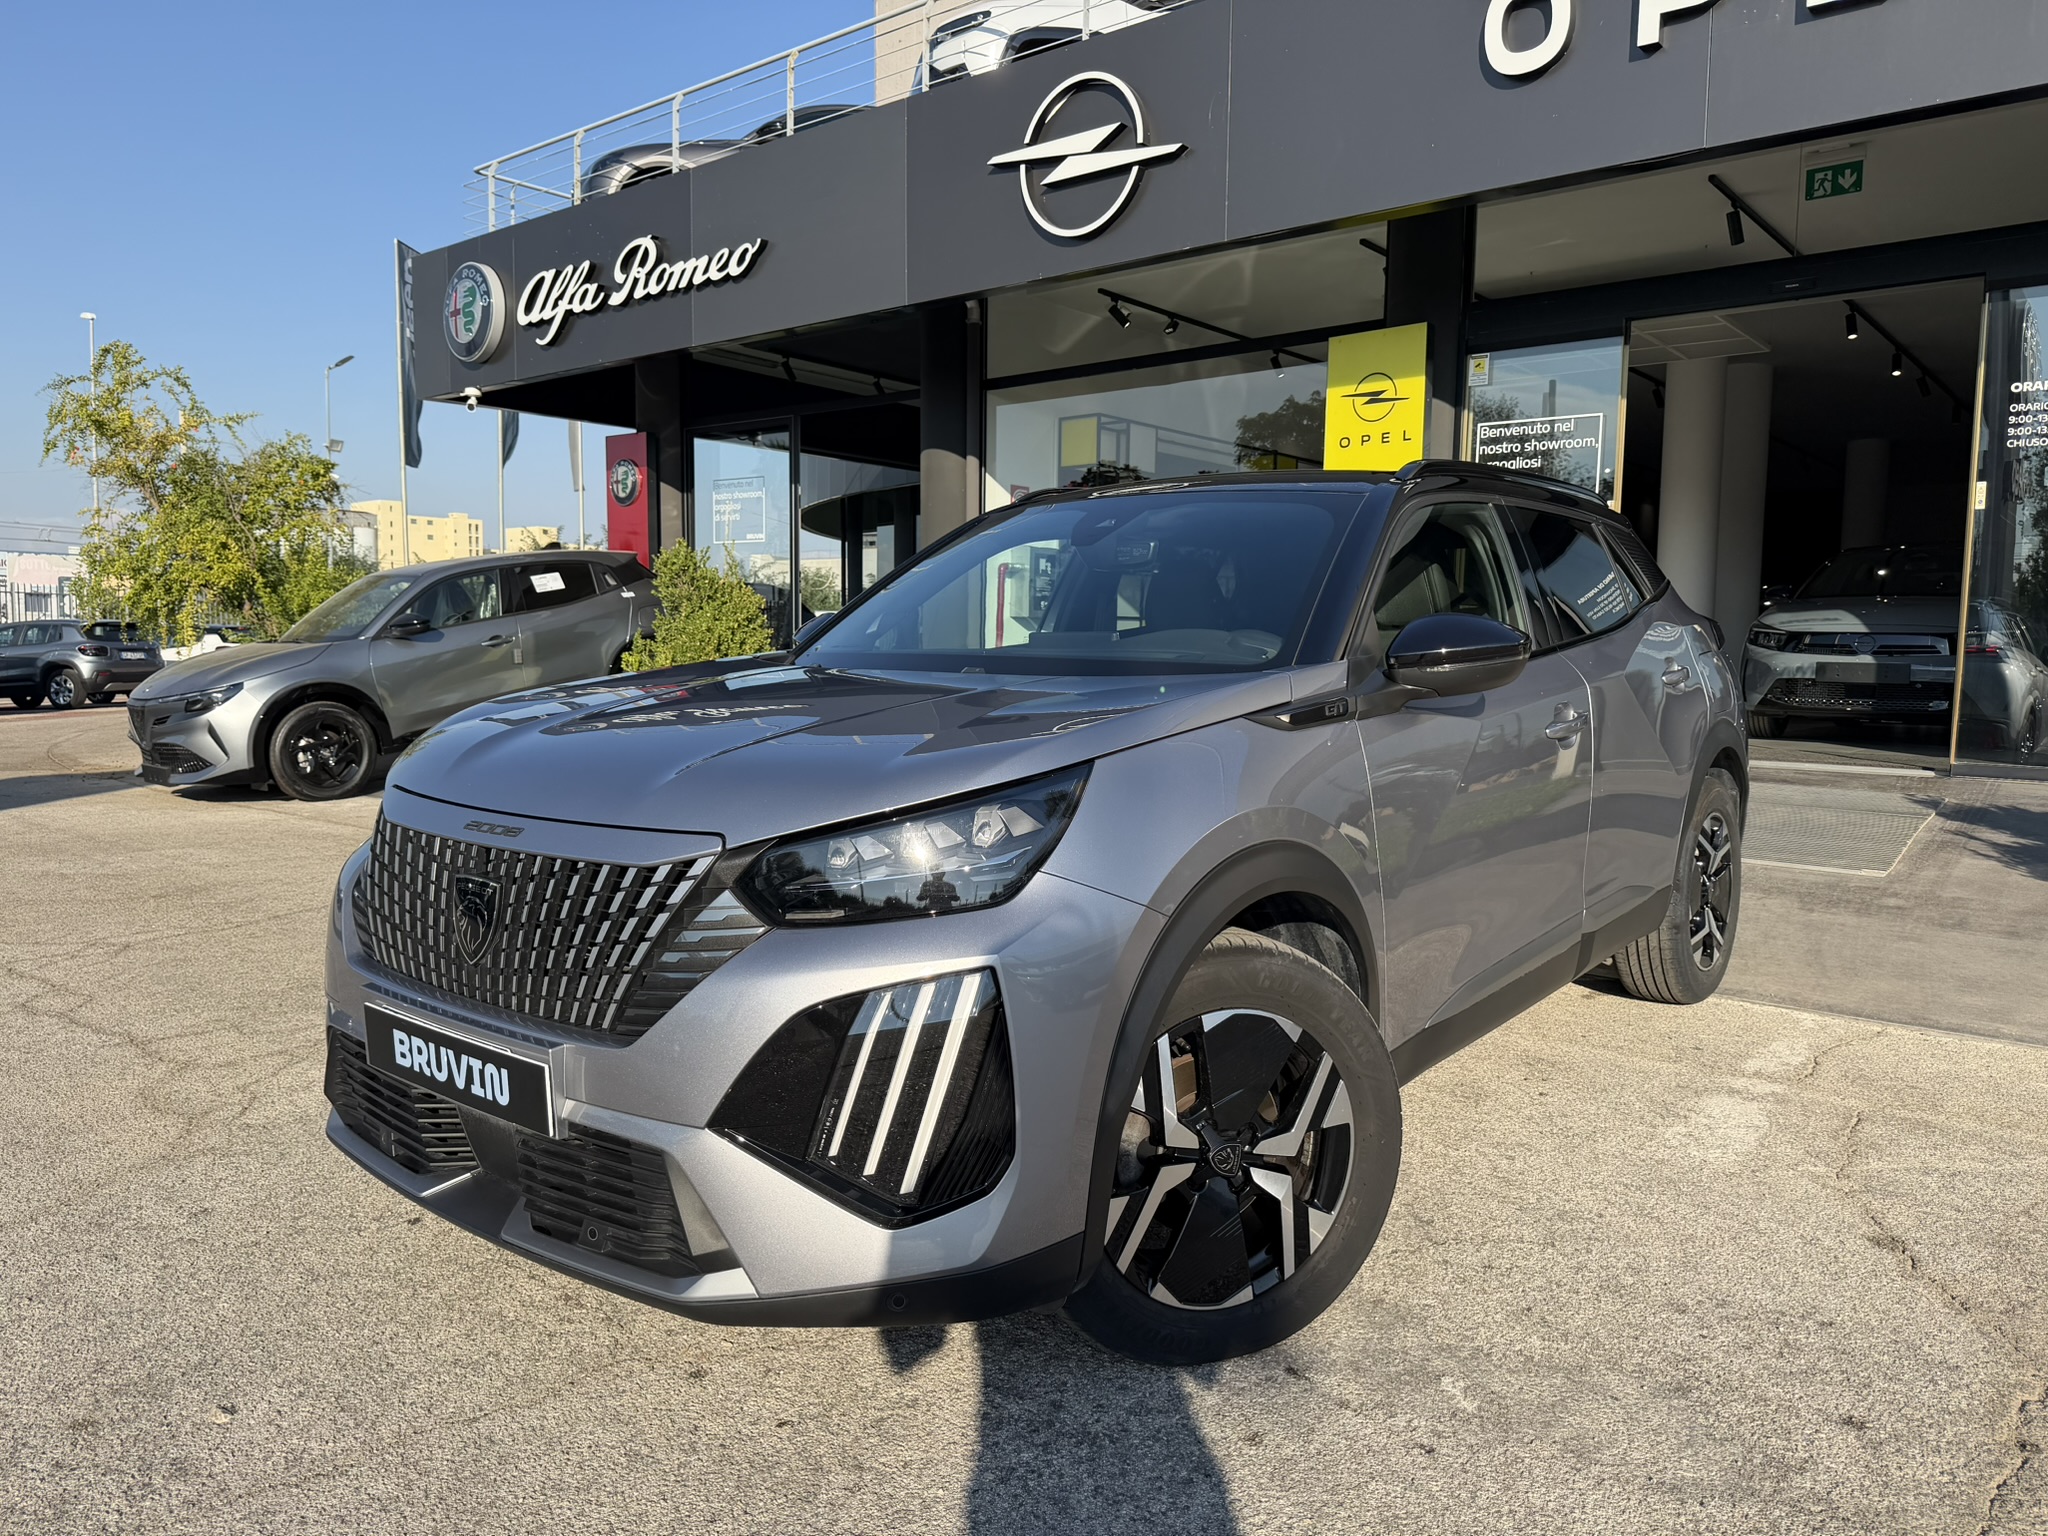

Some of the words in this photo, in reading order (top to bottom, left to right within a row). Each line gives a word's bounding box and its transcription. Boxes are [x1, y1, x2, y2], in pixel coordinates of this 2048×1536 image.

[462, 268, 490, 307] ROMEO
[516, 260, 607, 346] Alfa
[608, 234, 763, 307] Romeo
[1339, 429, 1412, 449] OPEL
[1480, 422, 1551, 439] Benvenuto
[1554, 418, 1575, 433] nel
[1479, 440, 1521, 456] nostro
[1523, 434, 1599, 452] showroom,
[2006, 438, 2048, 448] CHIUSO
[1325, 701, 1346, 716] GT
[463, 820, 525, 837] 2008
[393, 1028, 511, 1106] BRUVIN
